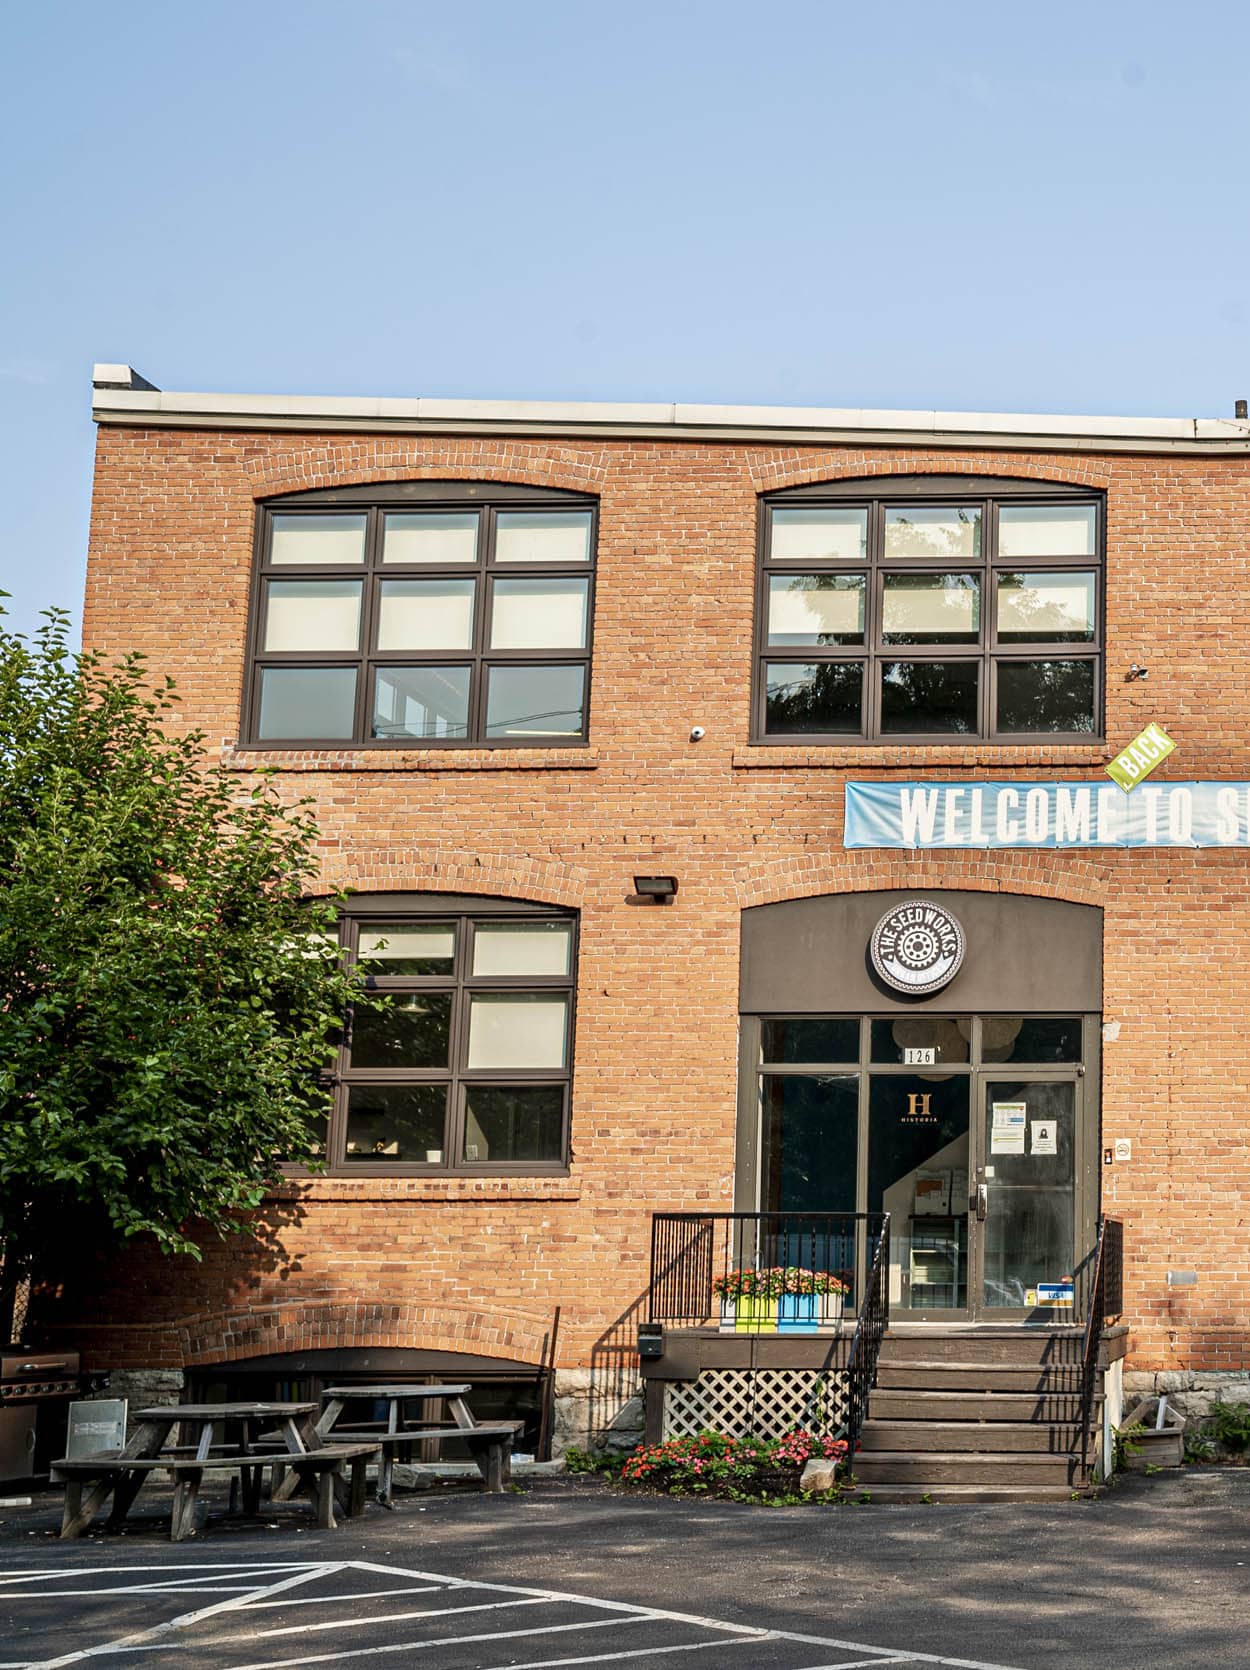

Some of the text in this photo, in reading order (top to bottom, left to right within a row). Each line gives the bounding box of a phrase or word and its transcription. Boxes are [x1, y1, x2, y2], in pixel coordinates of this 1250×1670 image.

[1117, 726, 1171, 778] BACK
[900, 788, 1118, 843] WELCOME
[1142, 788, 1193, 843] TO
[880, 908, 957, 955] THE SEEDWORKS
[909, 1050, 930, 1063] 126
[907, 1093, 932, 1115] H
